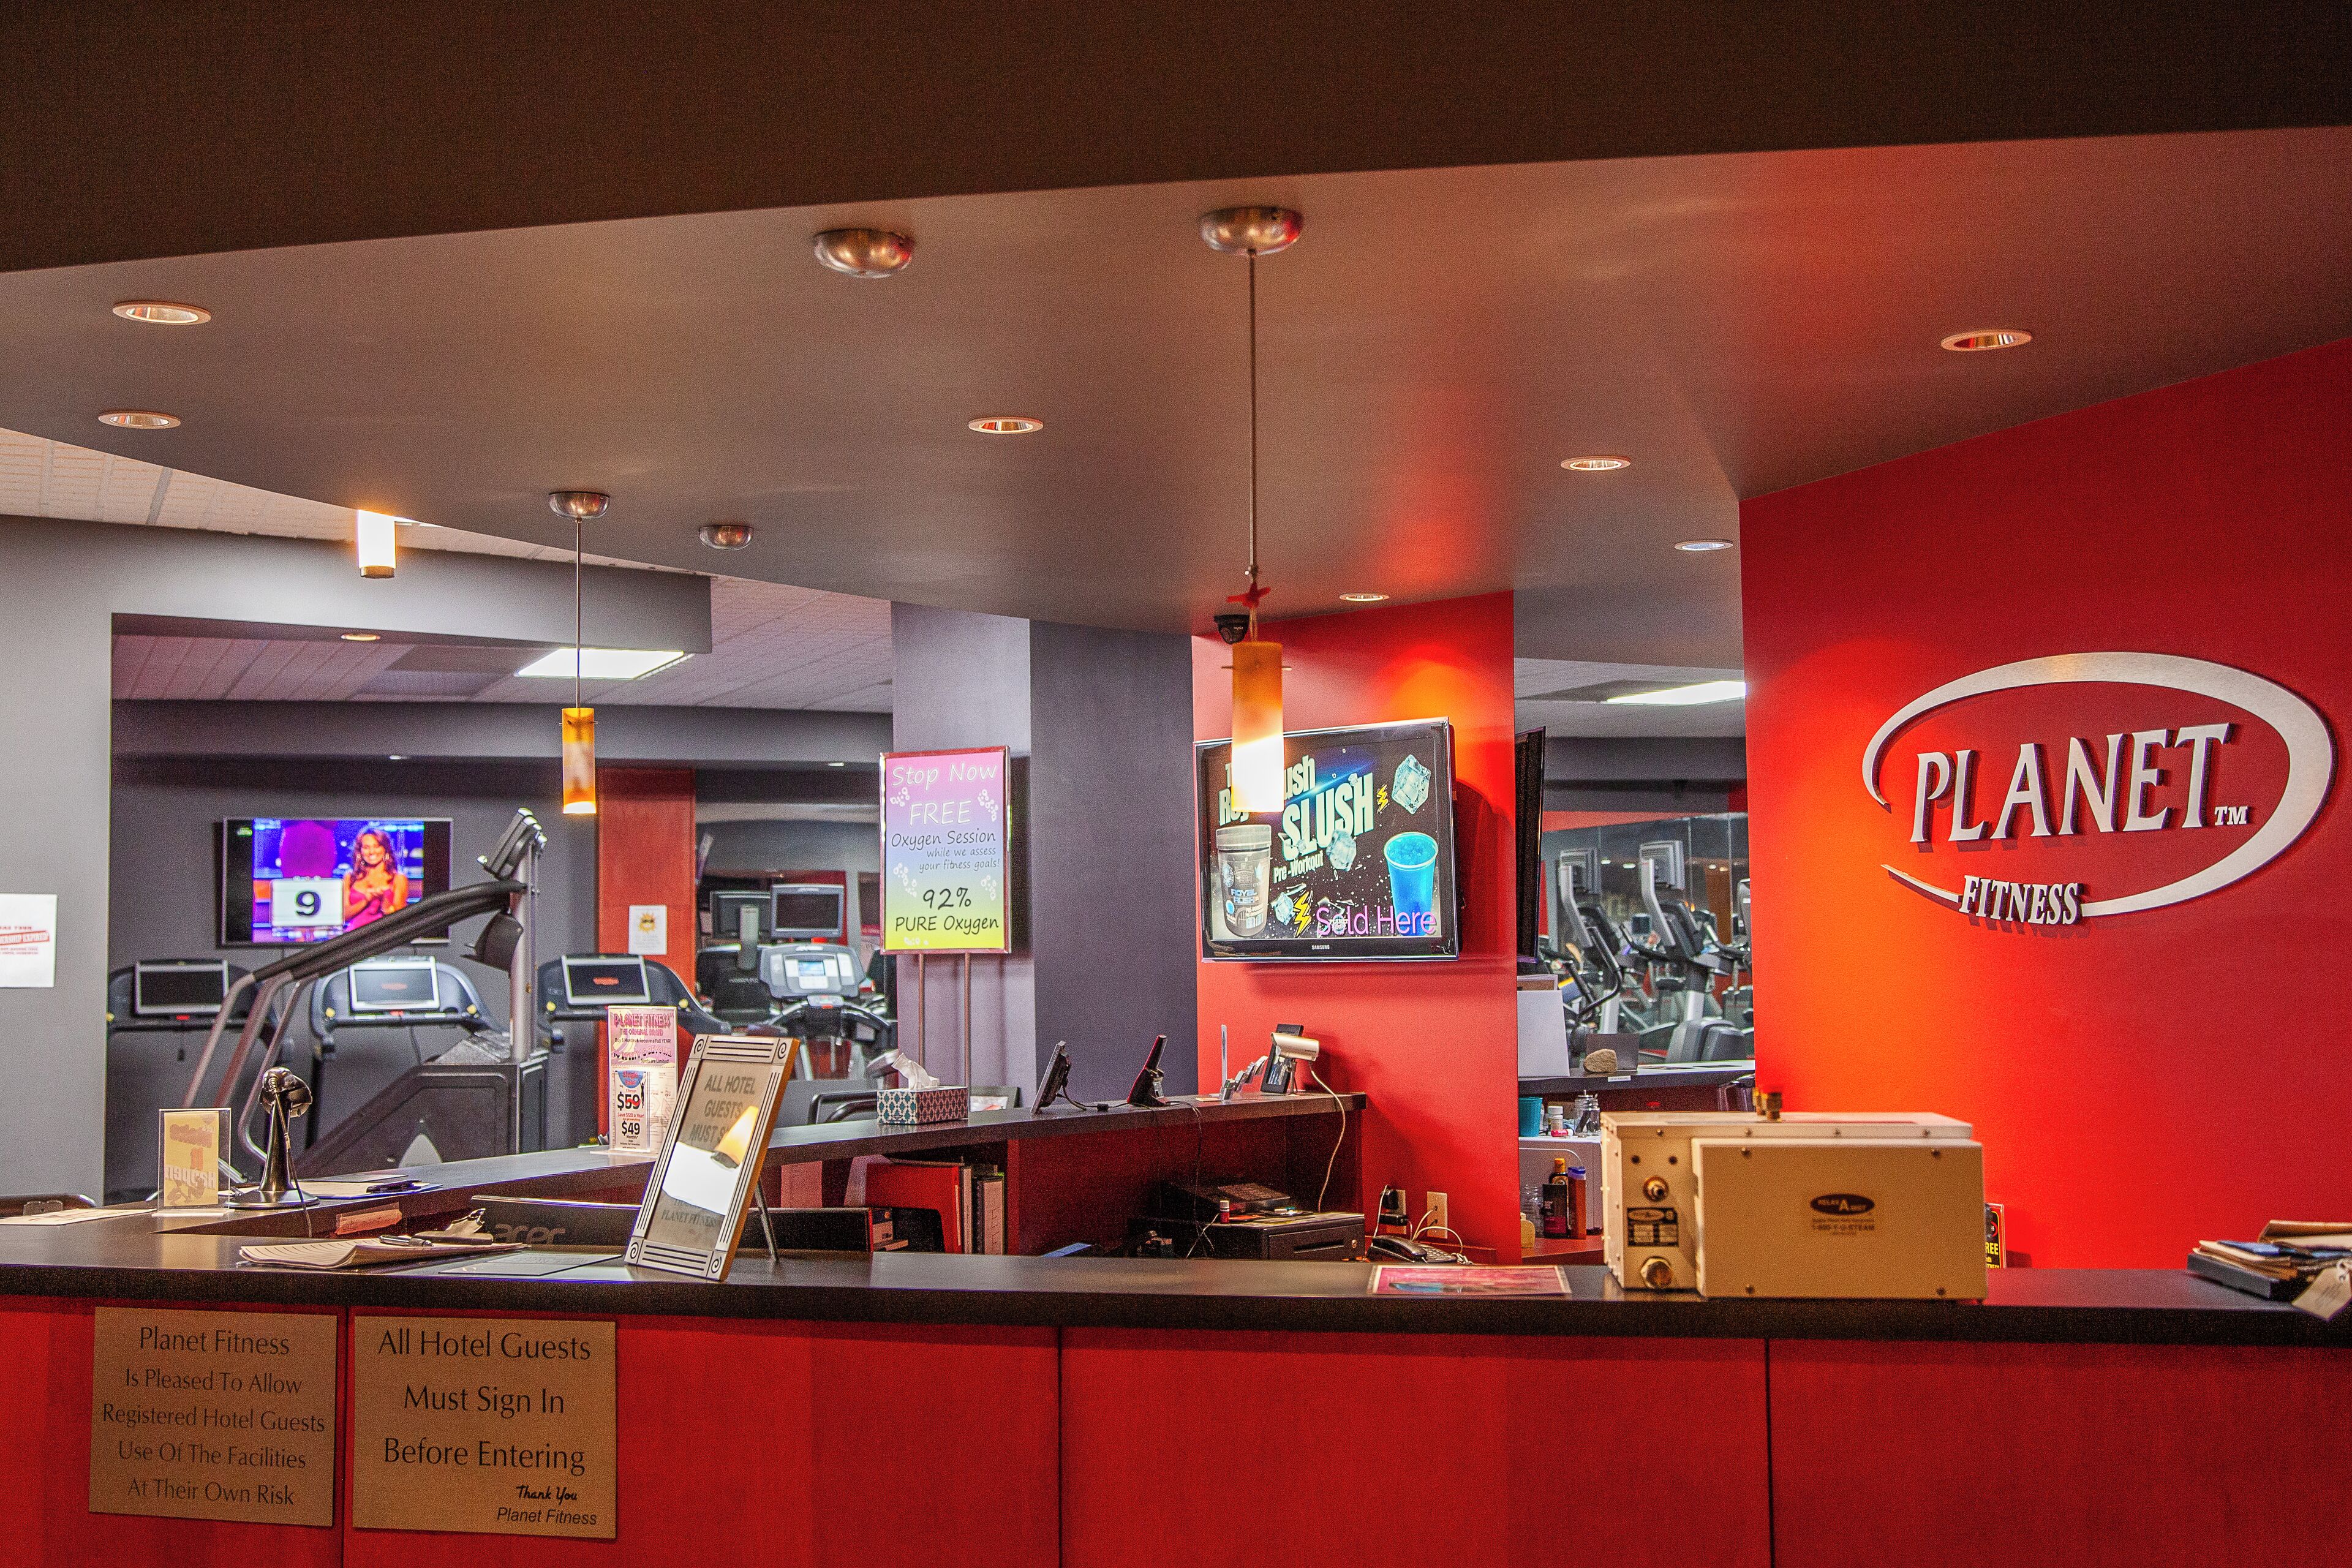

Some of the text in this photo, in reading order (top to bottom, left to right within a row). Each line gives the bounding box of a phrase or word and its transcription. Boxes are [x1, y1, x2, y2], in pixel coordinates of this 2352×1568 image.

[892, 762, 998, 791] Stop Now
[1910, 723, 2249, 843] PLANET TM
[910, 800, 972, 827] FREE
[1283, 772, 1374, 861] SLUSH
[891, 827, 996, 850] Oxygen Session
[919, 858, 1000, 873] your fitness goals!
[927, 848, 950, 858] while
[295, 890, 322, 916] 9
[922, 886, 972, 910] 92%
[1959, 875, 2081, 925] FITNESS
[895, 914, 1000, 935] PURE Oxygen
[1316, 905, 1437, 936] Sold Here
[614, 1014, 642, 1027] PLANET
[643, 1014, 671, 1027] FITNESS
[704, 1075, 756, 1095] ALL HOTEL
[617, 1091, 641, 1111] $59
[622, 1120, 640, 1136] $49
[689, 1123, 718, 1142] MUST
[494, 1224, 566, 1245] acer
[140, 1326, 290, 1355] Planet Fitness
[378, 1327, 590, 1360] All Hotel Guests
[126, 1368, 303, 1393] Is Pleased To Allow
[404, 1384, 565, 1419] Must Sign In
[103, 1403, 325, 1432] Registered Hotel Guests
[119, 1441, 306, 1469] Use Of The Facilities
[385, 1437, 586, 1476] Before Entering
[127, 1479, 294, 1505] At Their Own Risk
[516, 1485, 577, 1506] Thank You
[497, 1507, 597, 1526] Planet Fitness
